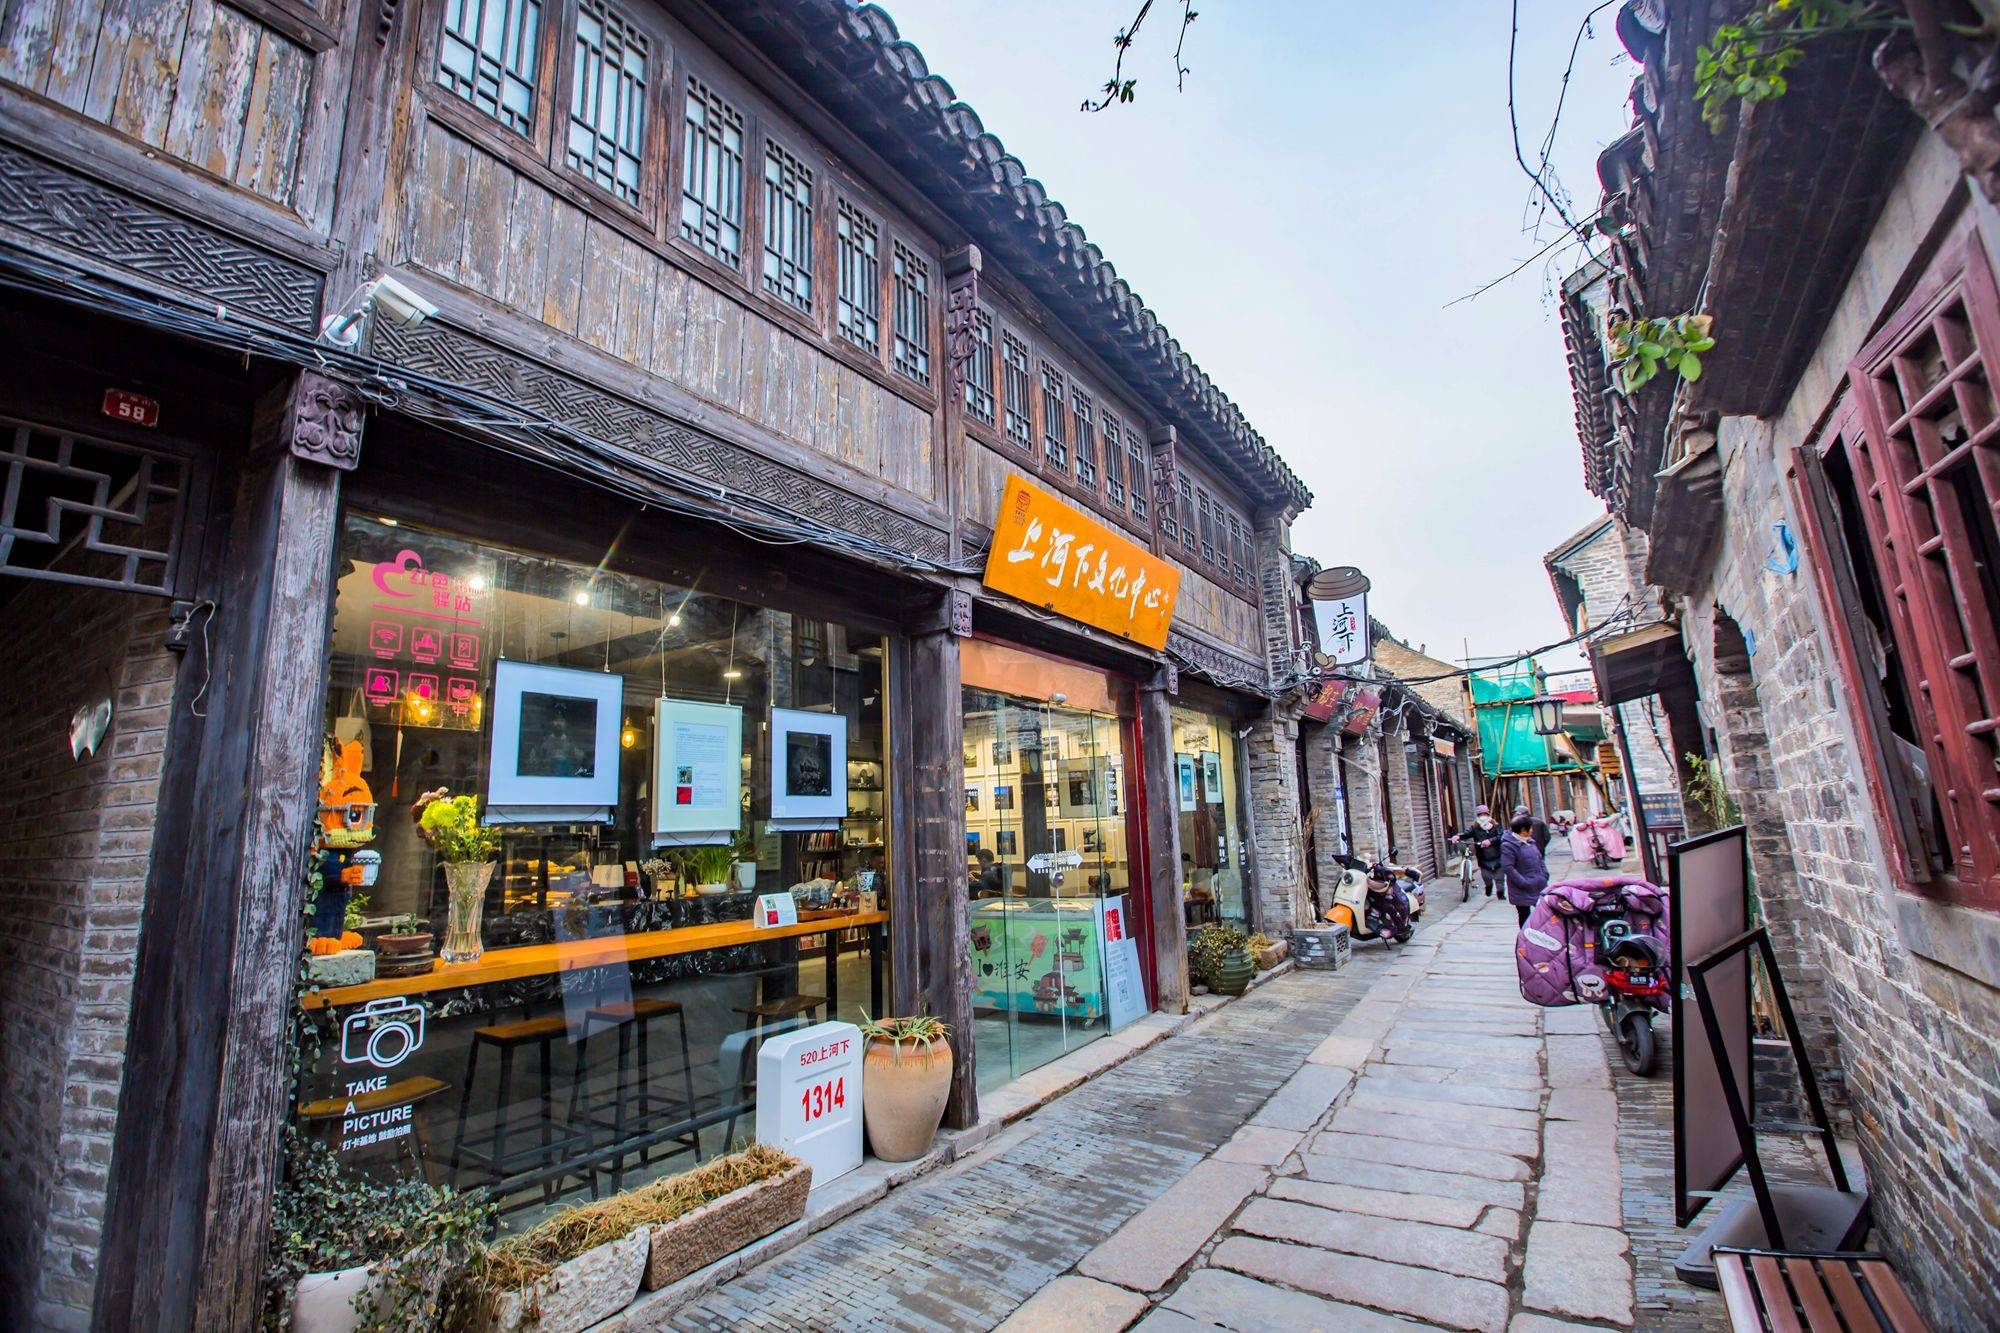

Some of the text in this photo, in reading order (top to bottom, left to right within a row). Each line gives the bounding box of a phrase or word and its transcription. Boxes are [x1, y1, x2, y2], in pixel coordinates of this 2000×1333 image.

[119, 402, 145, 421] 58
[409, 567, 449, 589] 红色
[1008, 517, 1161, 620] 上河下文化中心
[433, 592, 471, 613] 驿站
[1326, 602, 1354, 652] 上河下
[800, 1039, 850, 1066] 520上河下
[345, 1075, 388, 1097] TAKE
[343, 1101, 356, 1116] A
[802, 1077, 845, 1122] 1314
[343, 1104, 413, 1135] PICTURE
[342, 1133, 377, 1152] 打卡基地
